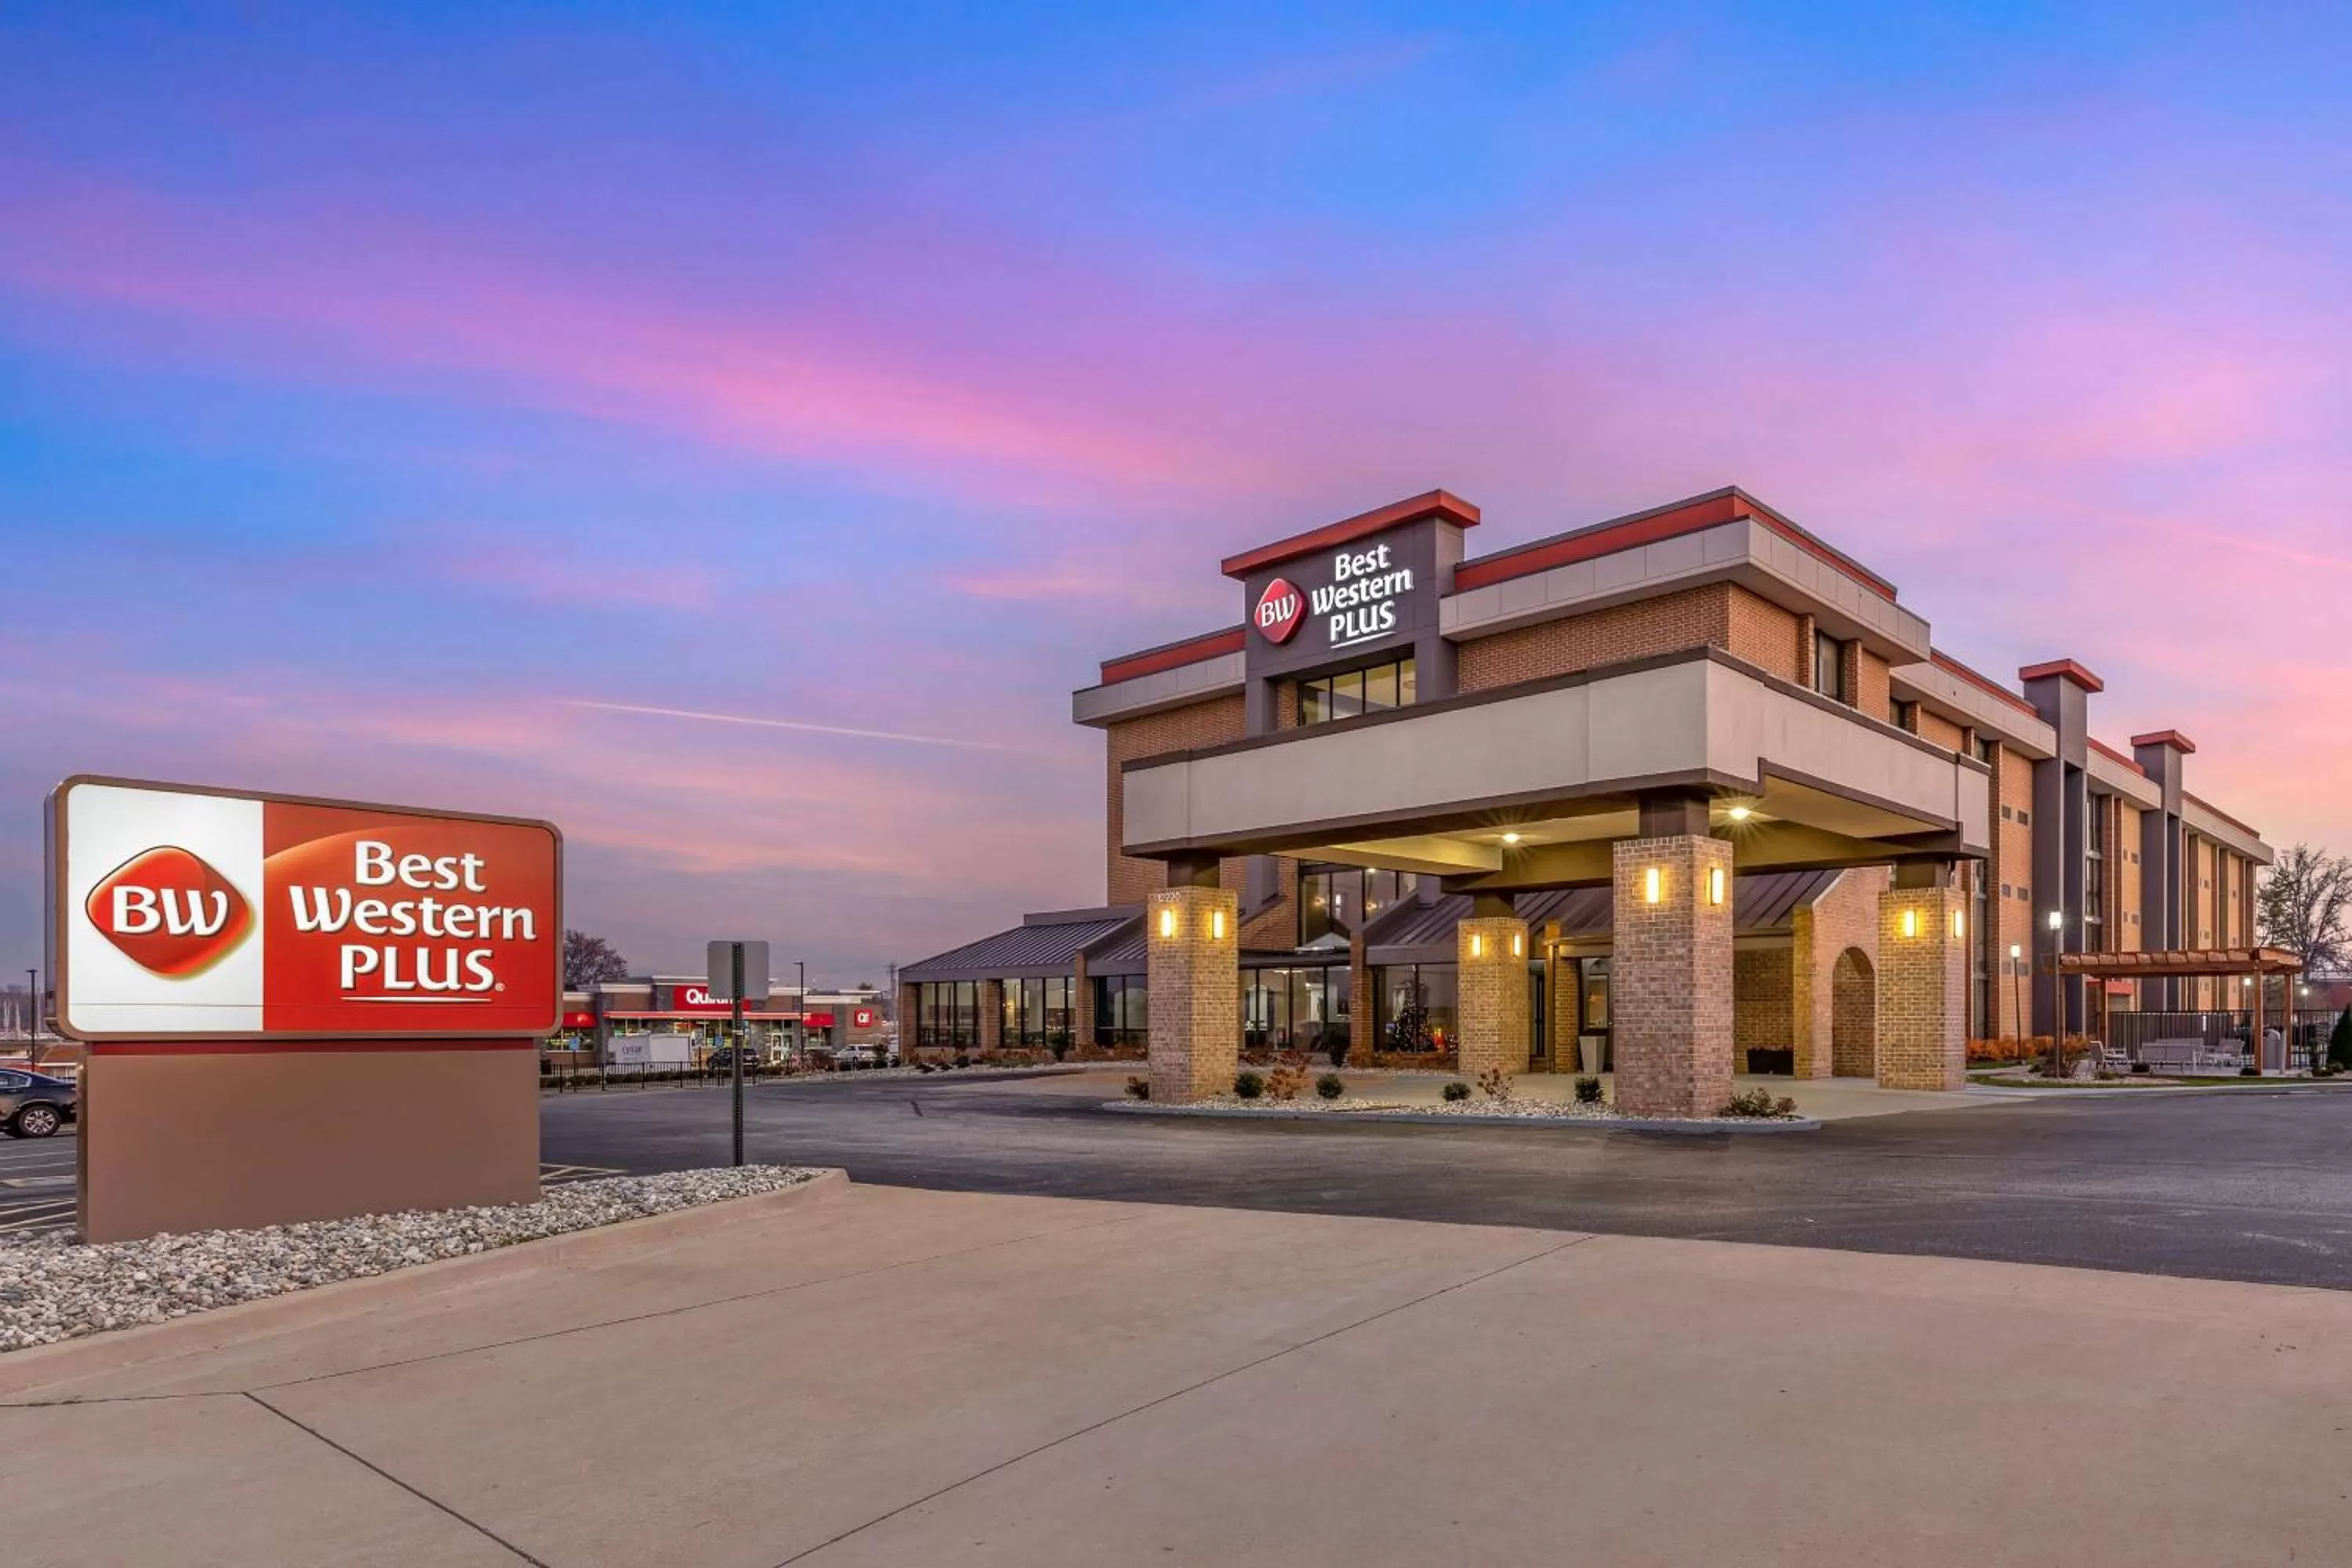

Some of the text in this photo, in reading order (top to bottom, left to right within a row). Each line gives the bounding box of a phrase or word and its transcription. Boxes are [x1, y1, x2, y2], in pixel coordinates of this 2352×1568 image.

[1335, 544, 1390, 581] Best
[1261, 593, 1296, 628] BW
[1312, 569, 1414, 615] Western
[1330, 599, 1395, 642] PLUS
[355, 840, 486, 891] Best
[113, 885, 228, 936] BW
[289, 885, 536, 940] Western
